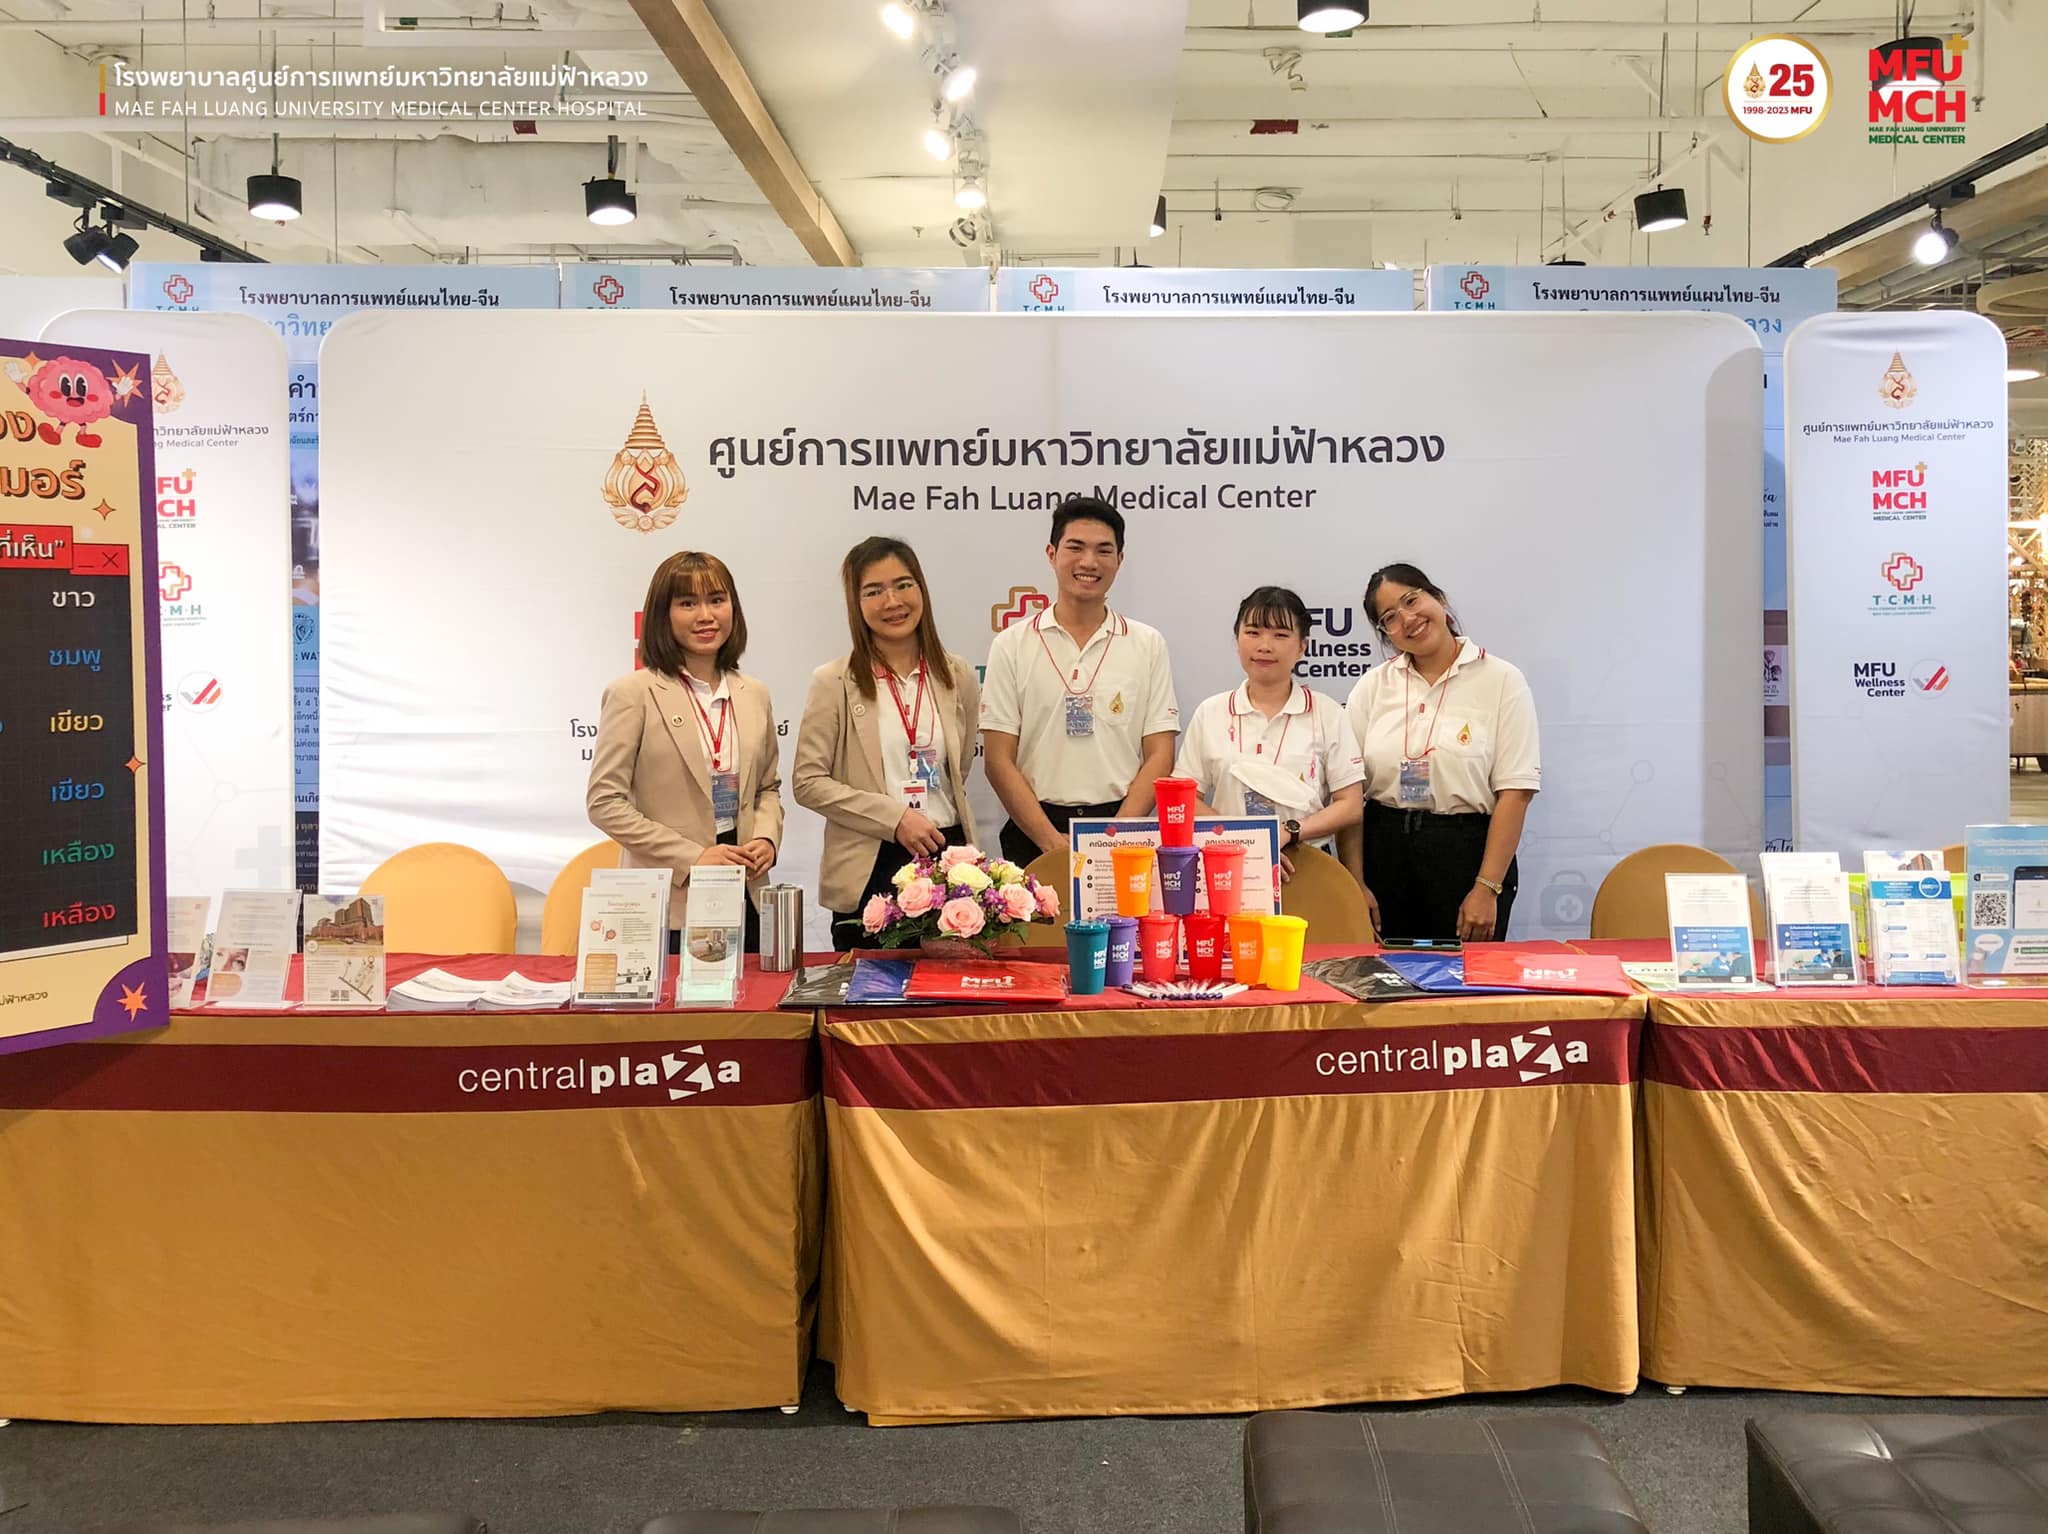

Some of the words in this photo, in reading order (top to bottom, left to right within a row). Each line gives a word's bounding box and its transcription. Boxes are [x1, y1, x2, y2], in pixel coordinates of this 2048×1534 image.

[239, 286, 500, 308] โรงพยาบาลการแพทย์แผนไทย-จีน
[669, 286, 932, 309] โรงพยาบาลการแพทย์แผนไทย-จีน
[1103, 285, 1355, 307] โรงพยาบาลการแพทย์แผนไทย-จีน
[1533, 282, 1781, 305] โรงพยาบาลการแพทย์แผนไทย-จีน
[1803, 419, 1994, 437] ศูนย์การแพทย์มหาวิทยาลัยแม่ฟ้าหลวง
[1833, 435, 1852, 444] Mae
[1854, 435, 1870, 443] Fah
[1872, 434, 1899, 445] Luang
[1901, 433, 1935, 442] Medical
[1936, 433, 1966, 441] Center
[166, 439, 204, 448] Medical
[206, 438, 239, 447] Center
[709, 425, 1446, 479] ศูนย์การแพทย์มหาวิทยาลัยแม่ฟ้าหลวง
[1872, 470, 1925, 487] MFU
[853, 485, 915, 511] Mae
[926, 485, 979, 511] Fah
[1093, 484, 1207, 510] Medical
[1217, 484, 1317, 510] Center
[1872, 492, 1927, 510] MCH
[51, 591, 96, 608] ขาว
[48, 648, 102, 672] ชมพู
[1853, 662, 1896, 677] MFU
[1855, 678, 1906, 688] Wellness
[1867, 688, 1906, 697] Center
[50, 709, 105, 733] เขียว
[51, 778, 105, 802] เขียว
[42, 839, 116, 866] เหลือง
[43, 901, 117, 929] เหลือง
